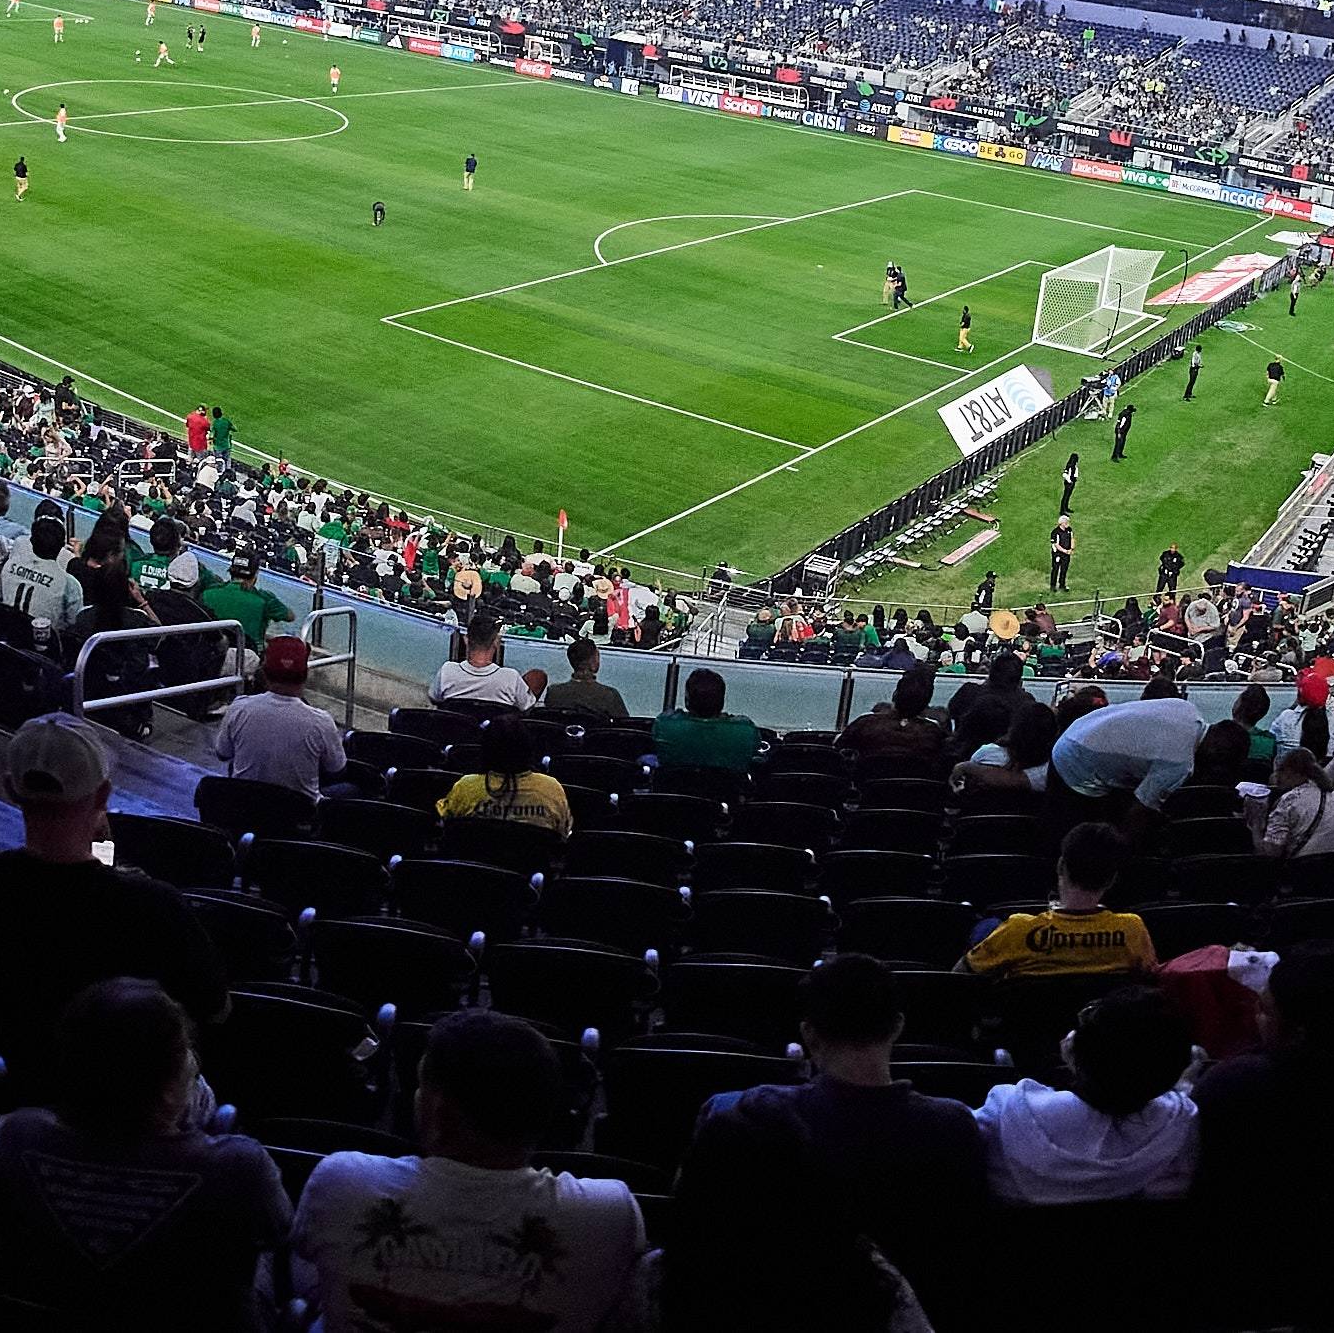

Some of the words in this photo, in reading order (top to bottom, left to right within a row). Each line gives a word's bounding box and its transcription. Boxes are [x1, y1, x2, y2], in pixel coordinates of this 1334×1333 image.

[689, 91, 718, 108] VISA
[723, 97, 759, 115] Scribe
[905, 93, 923, 104] AT&T
[773, 108, 801, 121] MetLif
[870, 102, 893, 115] AT&T
[980, 145, 993, 156] BE
[1009, 150, 1024, 160] GO
[1141, 139, 1185, 153] MEXTOUR
[965, 387, 1011, 443] AT&T
[9, 563, 54, 588] S.GIMENEZ
[476, 797, 547, 819] Corona
[1025, 924, 1126, 955] Corona
